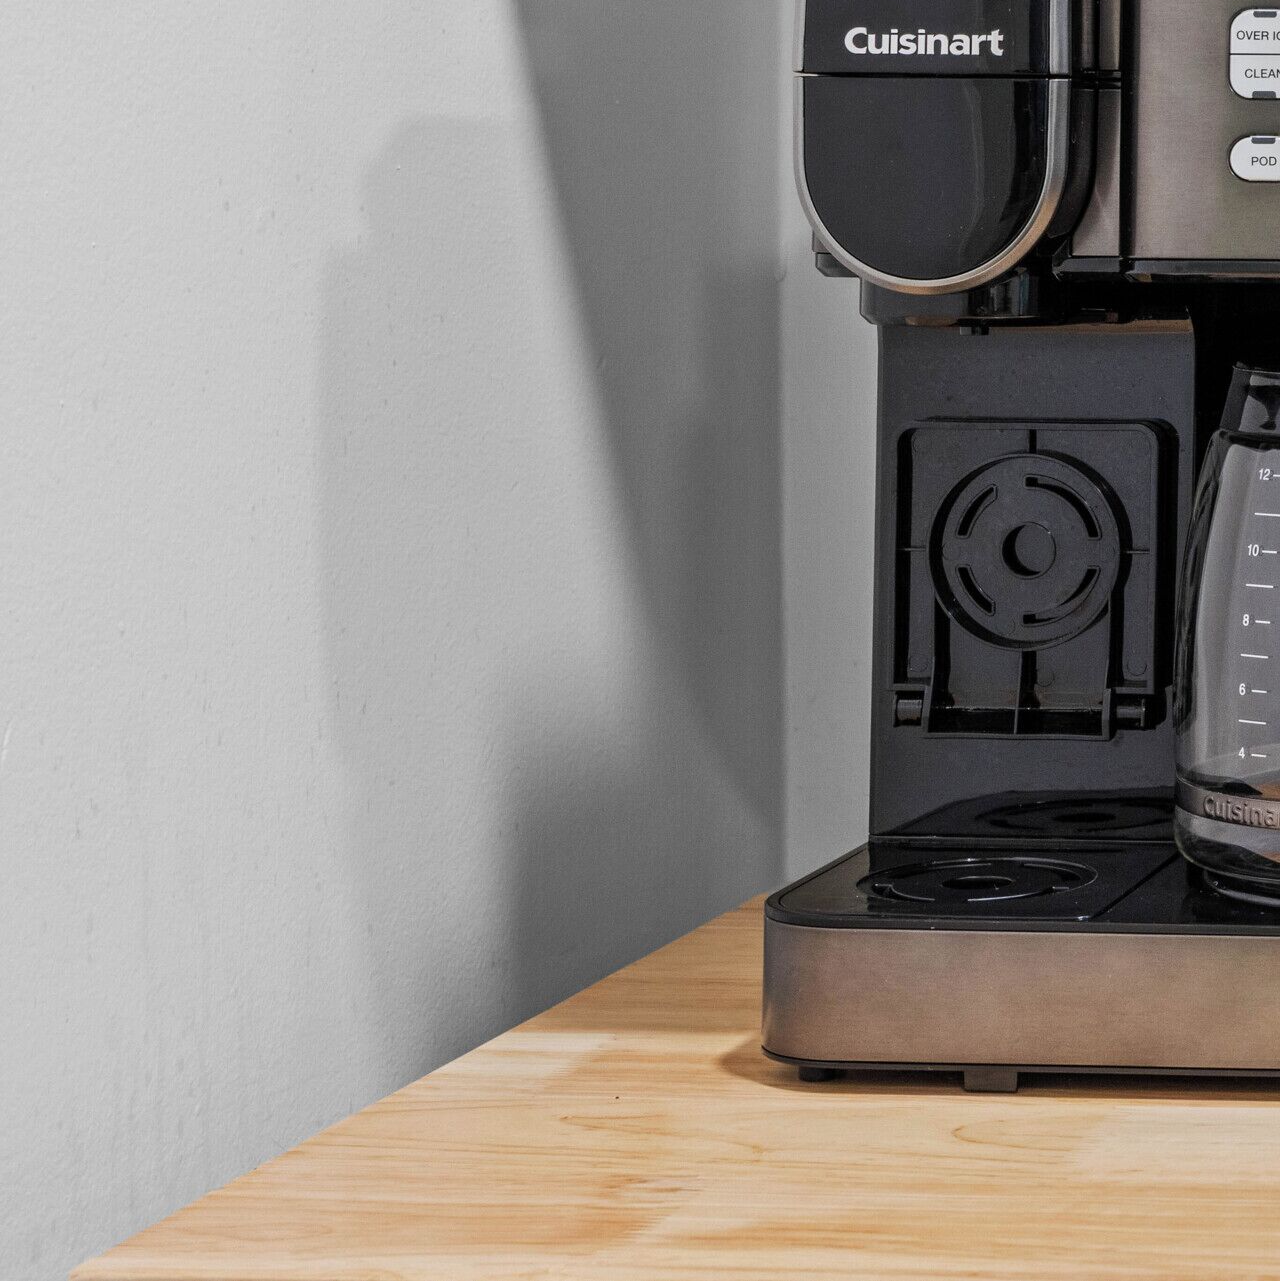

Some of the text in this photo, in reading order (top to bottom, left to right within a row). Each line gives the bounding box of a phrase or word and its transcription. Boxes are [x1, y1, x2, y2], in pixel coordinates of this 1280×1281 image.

[844, 26, 1004, 57] Cuisinart
[1236, 30, 1268, 41] OVER
[1250, 155, 1277, 167] POD
[1258, 468, 1271, 481] 12
[1247, 544, 1260, 557] 10
[1242, 614, 1250, 627] 8
[1238, 683, 1246, 695] 6
[1238, 746, 1246, 758] 4
